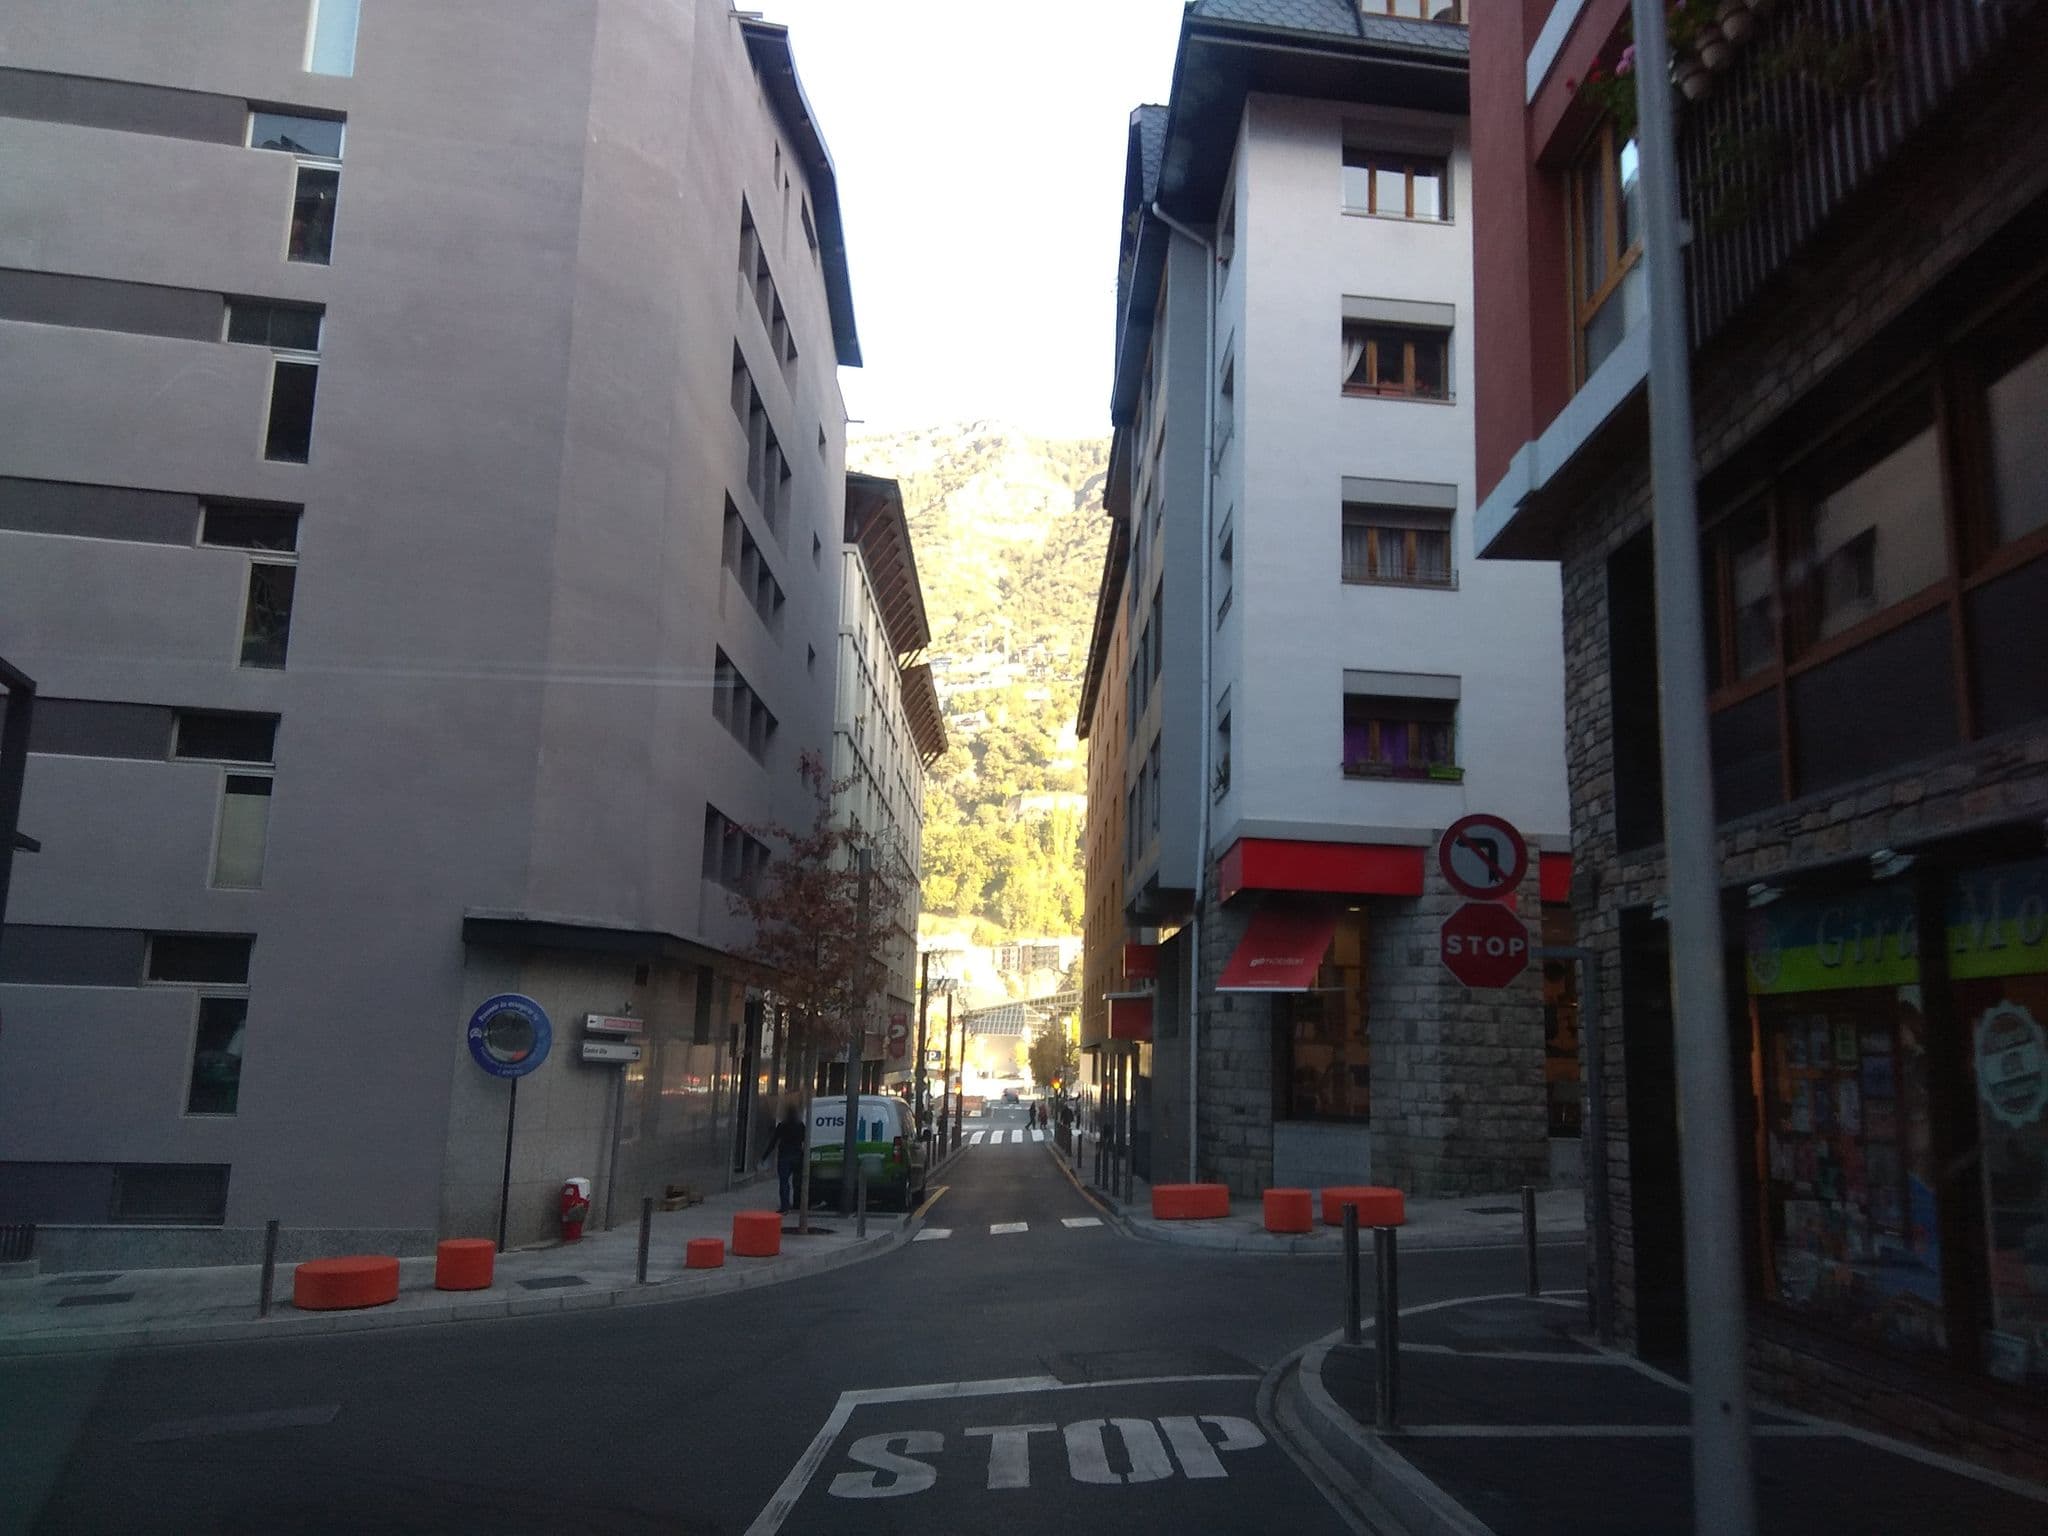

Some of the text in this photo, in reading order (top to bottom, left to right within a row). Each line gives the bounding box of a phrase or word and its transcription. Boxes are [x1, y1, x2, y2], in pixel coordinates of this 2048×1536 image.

[1446, 934, 1526, 958] STOP
[928, 1051, 937, 1060] P
[815, 1116, 845, 1127] OTIS
[828, 1415, 1267, 1499] STOP
